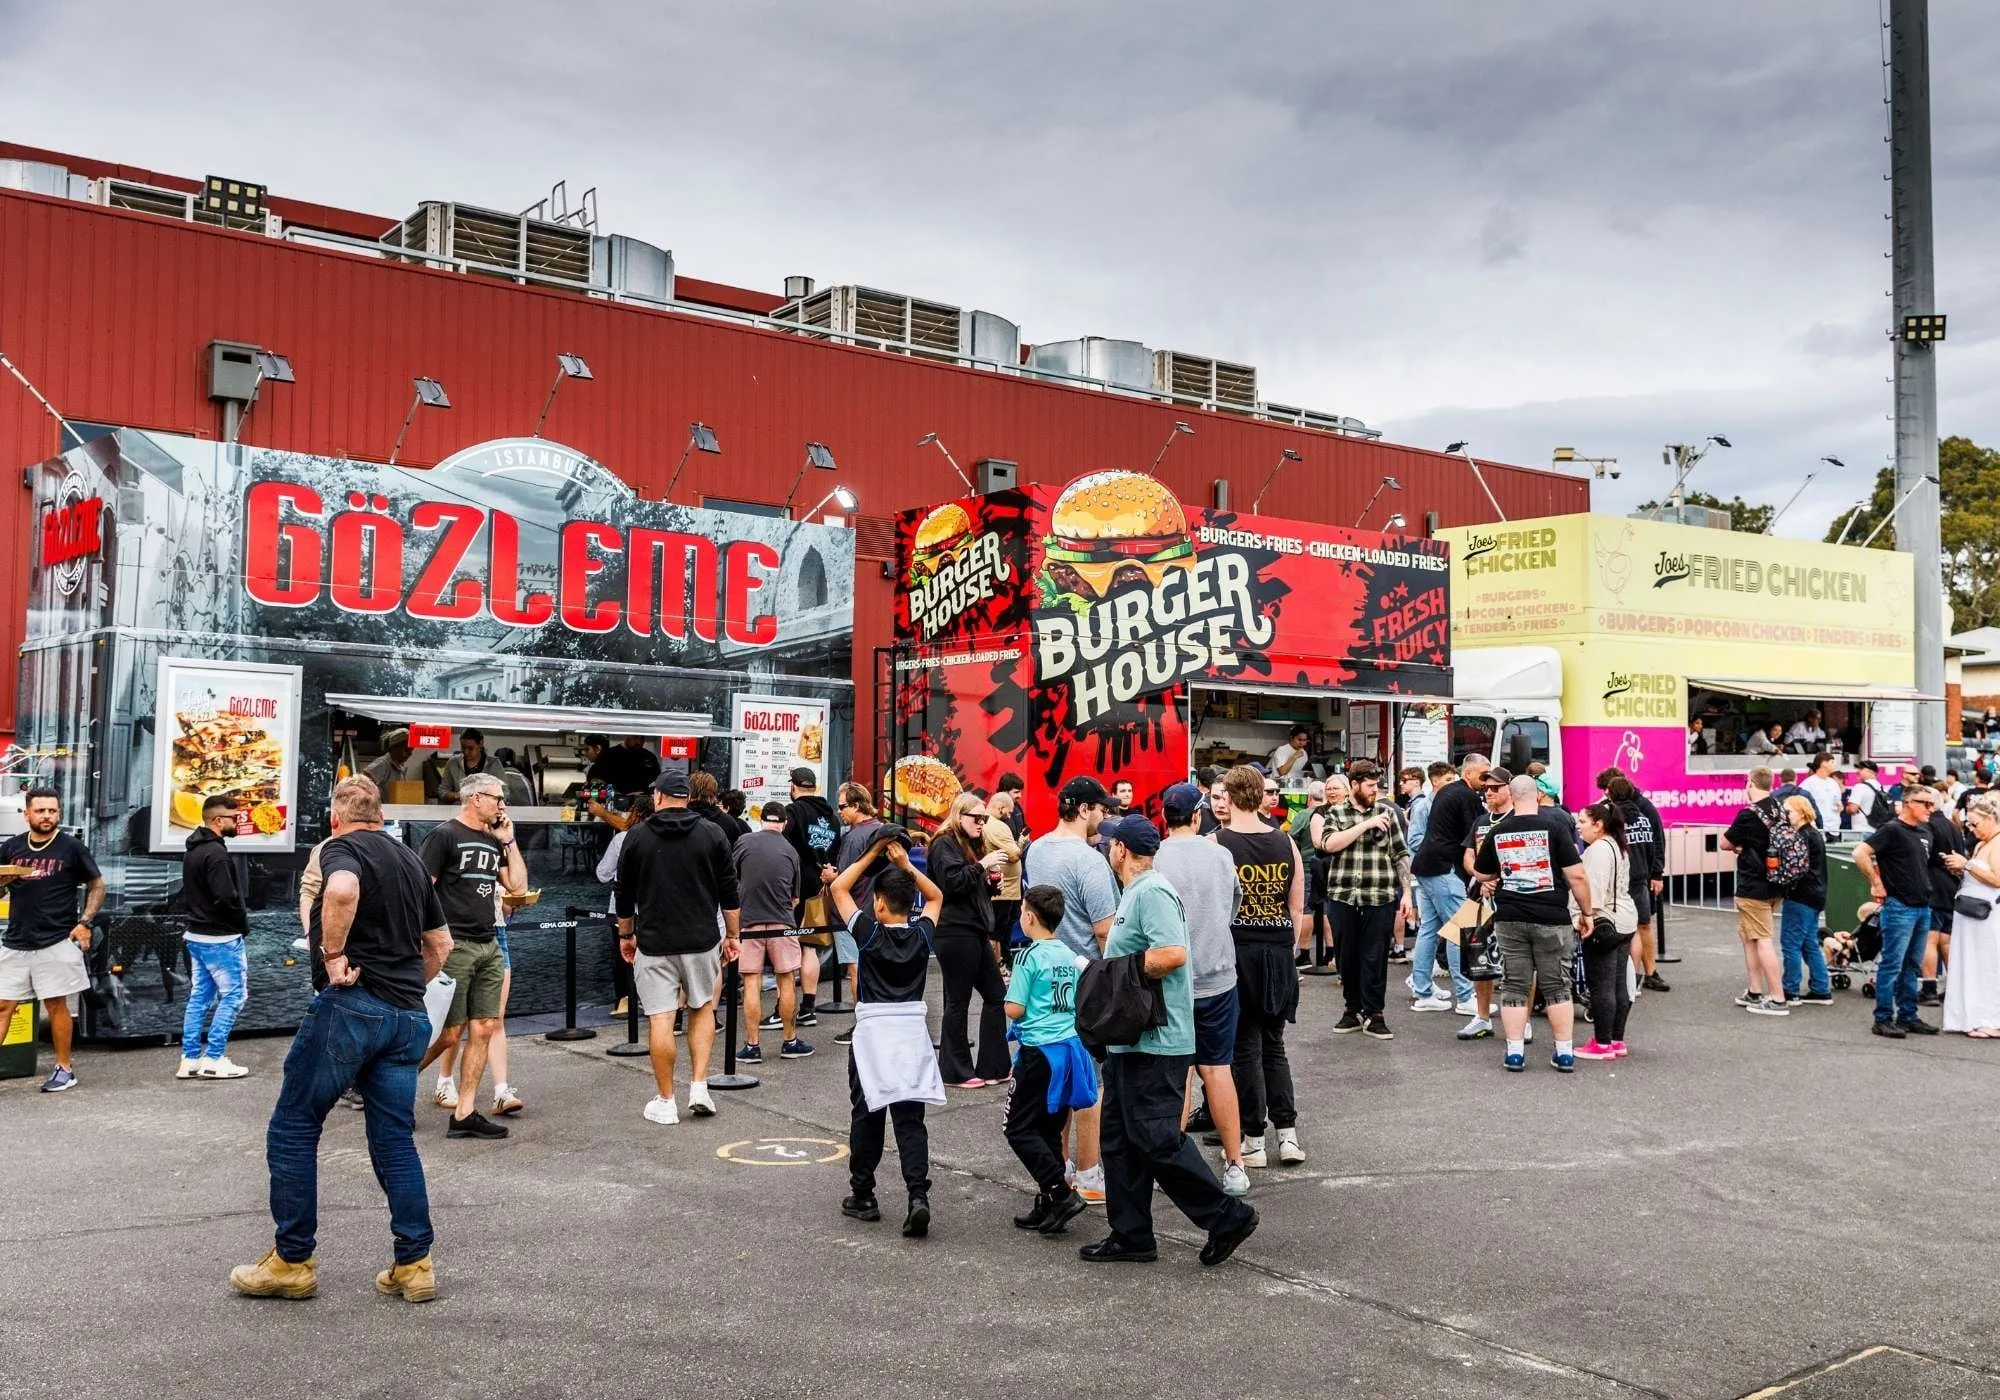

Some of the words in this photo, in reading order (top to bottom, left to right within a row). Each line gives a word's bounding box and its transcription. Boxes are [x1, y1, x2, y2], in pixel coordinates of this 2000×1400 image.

[1200, 526, 1263, 549] BURGERS
[1266, 535, 1302, 555] FRIES
[1309, 541, 1362, 562] CHICKEN
[1365, 549, 1410, 568] LOADED
[1411, 554, 1444, 572] FRIES
[1496, 527, 1557, 551] FRIED
[1464, 549, 1557, 576] CHICKEN
[909, 531, 1011, 623] BURGER
[1688, 554, 1763, 593] FRIED
[1767, 563, 1867, 603] CHICKEN
[922, 566, 994, 642] HOUSE
[1481, 589, 1539, 603] BURGERS
[1035, 551, 1272, 681] BURGER
[1372, 586, 1446, 647] FRESH
[1524, 618, 1558, 631] FRIES
[1606, 612, 1676, 634] BURGERS
[1684, 618, 1750, 638] POPCORN
[1751, 623, 1806, 642] CHICKEN
[1813, 627, 1865, 646] TENDERS
[1871, 632, 1903, 648] FRIES
[1387, 618, 1448, 670] JUICY
[895, 659, 921, 671] URGERS
[921, 656, 940, 668] FRIES
[943, 653, 971, 666] CHICKEN
[971, 650, 999, 663] LOADED
[999, 648, 1020, 661] FRIES
[1072, 613, 1241, 727] HOUSE
[1630, 673, 1676, 694] FRIED
[1603, 696, 1677, 718] CHICKEN
[744, 778, 761, 788] FRIES
[459, 849, 500, 871] FOX
[1236, 862, 1289, 883] ONIC
[557, 920, 578, 928] GROUP
